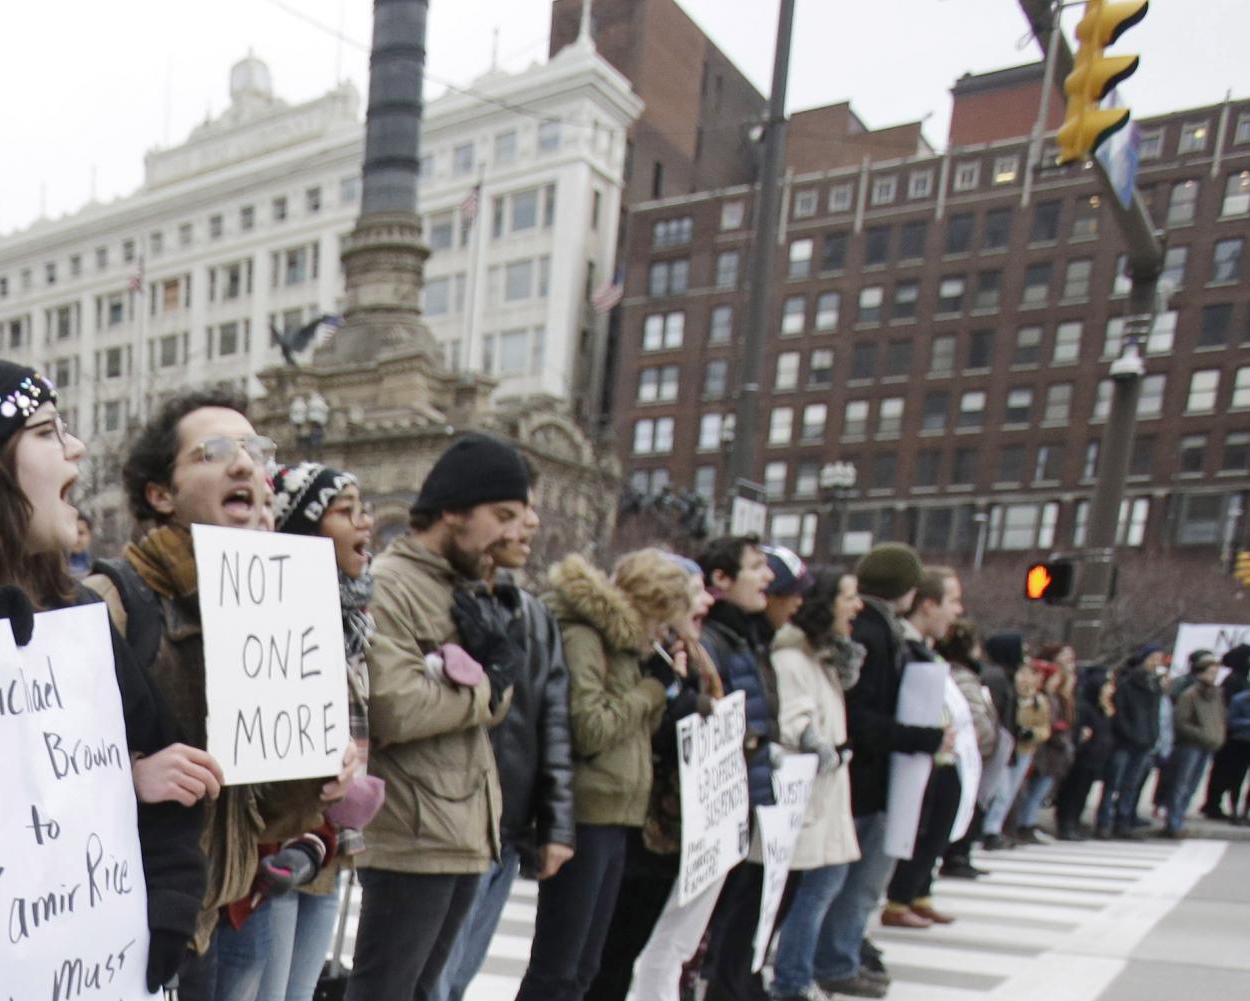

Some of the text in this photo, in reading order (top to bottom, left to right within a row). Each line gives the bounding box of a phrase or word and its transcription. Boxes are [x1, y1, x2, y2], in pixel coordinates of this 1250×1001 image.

[219, 550, 291, 607] NOT
[242, 626, 322, 680] ONE
[43, 731, 123, 780] Brown
[234, 702, 338, 767] MORE
[25, 804, 61, 845] to
[85, 832, 133, 908] Rice
